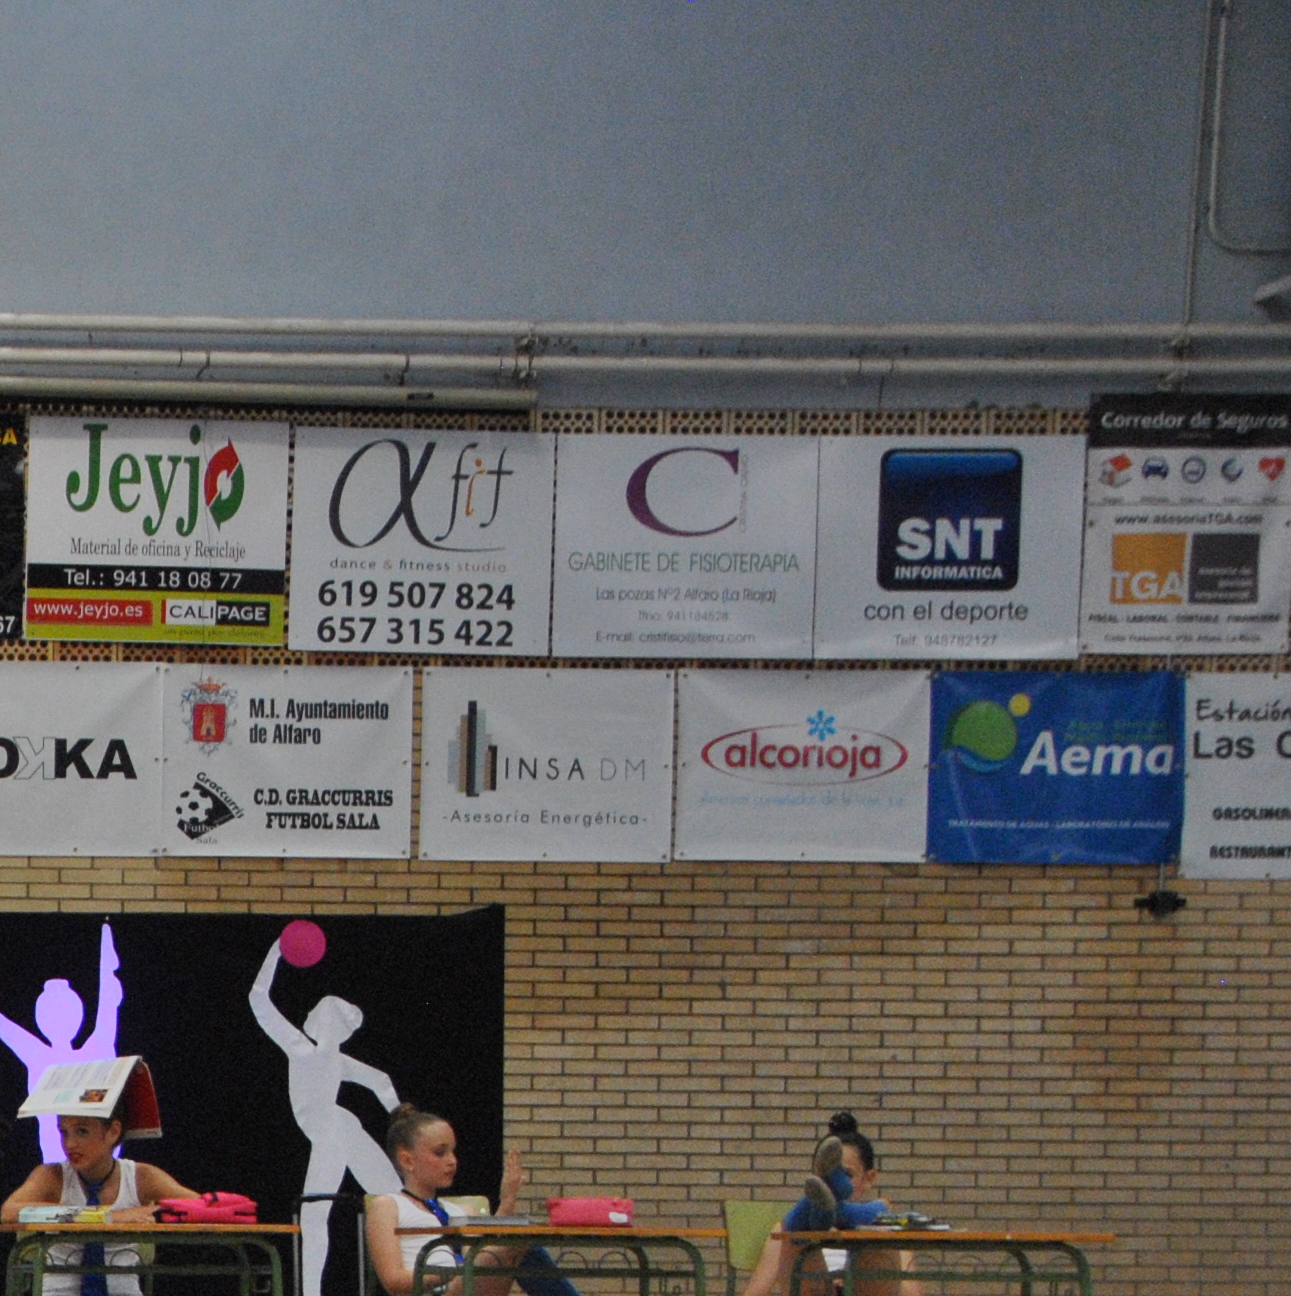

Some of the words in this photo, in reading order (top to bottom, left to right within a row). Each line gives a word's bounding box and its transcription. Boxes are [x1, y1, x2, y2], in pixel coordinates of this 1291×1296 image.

[1101, 411, 1185, 429] Corredor
[1190, 411, 1212, 429] de
[1217, 412, 1288, 433] Seguros
[65, 423, 246, 537] Jeyjo
[69, 538, 120, 555] Material
[124, 540, 139, 556] de
[141, 540, 181, 557] oficina
[183, 545, 191, 562] y
[195, 541, 247, 561] Reciclaje
[895, 517, 1004, 561] SNT
[329, 557, 376, 569] dance
[382, 560, 393, 570] &
[399, 559, 450, 572] fitness
[456, 561, 507, 573] studio
[568, 551, 650, 572] GABINETE
[657, 552, 679, 572] DE
[689, 552, 800, 573] FISIOTERAPIA
[894, 565, 1004, 580] INFORMATICA
[63, 568, 105, 587] Tel.:
[113, 570, 149, 588] 941
[157, 571, 180, 588] 18
[187, 571, 212, 589] 08
[219, 572, 243, 590] 77
[1110, 570, 1185, 601] TGA
[318, 579, 378, 608] 619
[387, 581, 446, 609] 507
[455, 582, 515, 611] 824
[596, 587, 616, 601] Las
[618, 590, 655, 603] pozas
[684, 587, 719, 601] Alfaro
[721, 587, 740, 603] (La
[33, 601, 144, 620] www.jeyjo.es
[864, 604, 906, 621] con
[913, 599, 933, 621] el
[940, 600, 1029, 625] deporte
[317, 615, 377, 644] 657
[386, 617, 445, 645] 315
[454, 618, 514, 647] 422
[248, 698, 280, 719] M.I.
[285, 699, 390, 722] Ayuntamiento
[248, 723, 267, 744] de
[272, 724, 322, 745] Alfaro
[1192, 731, 1255, 760] Las
[724, 731, 881, 778] alcorioja
[1019, 729, 1174, 777] Aema
[504, 757, 585, 781] INSA
[599, 757, 646, 781] DM
[253, 788, 283, 806] C.D.
[285, 788, 394, 807] GRACCURRIS
[265, 811, 333, 830] FUTBOL
[336, 813, 380, 830] SALA
